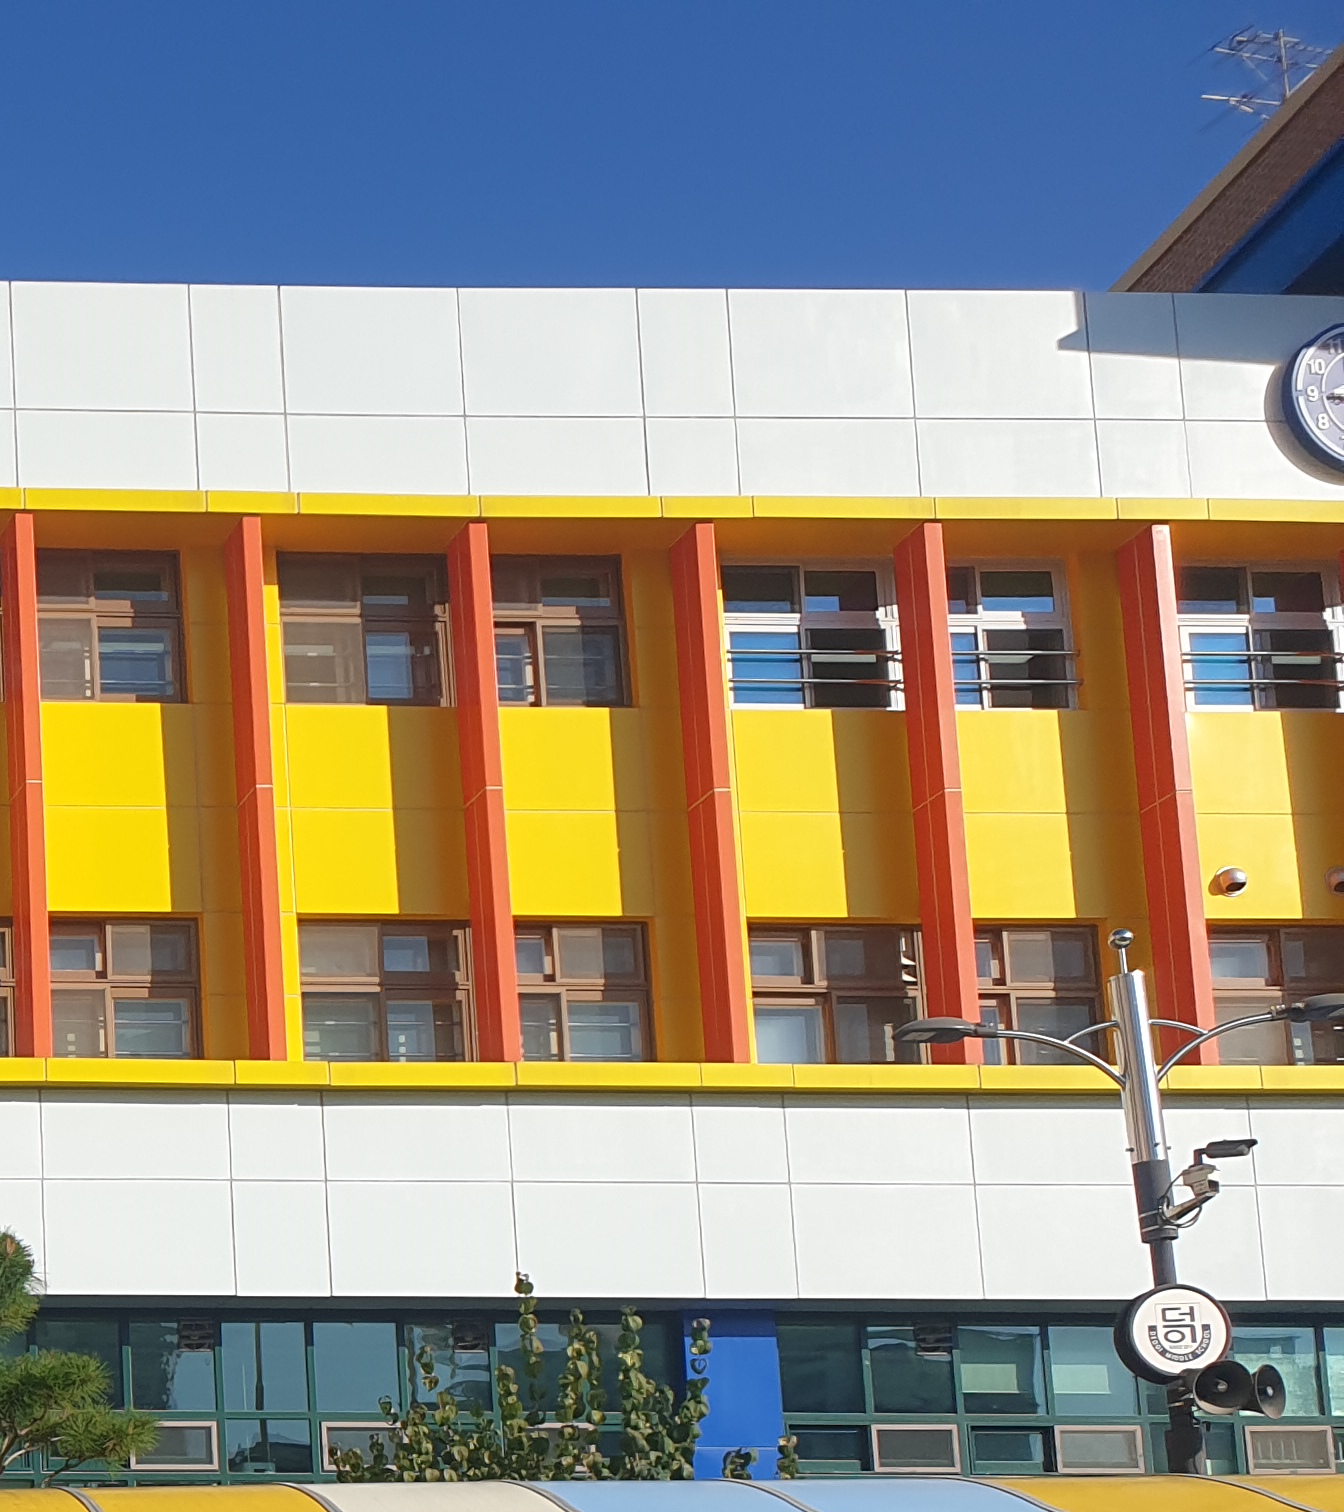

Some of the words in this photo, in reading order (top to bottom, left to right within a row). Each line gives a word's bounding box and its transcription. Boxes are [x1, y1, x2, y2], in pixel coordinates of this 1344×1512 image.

[1307, 358, 1326, 375] 10
[1306, 385, 1319, 402] 9
[1317, 413, 1330, 430] 8
